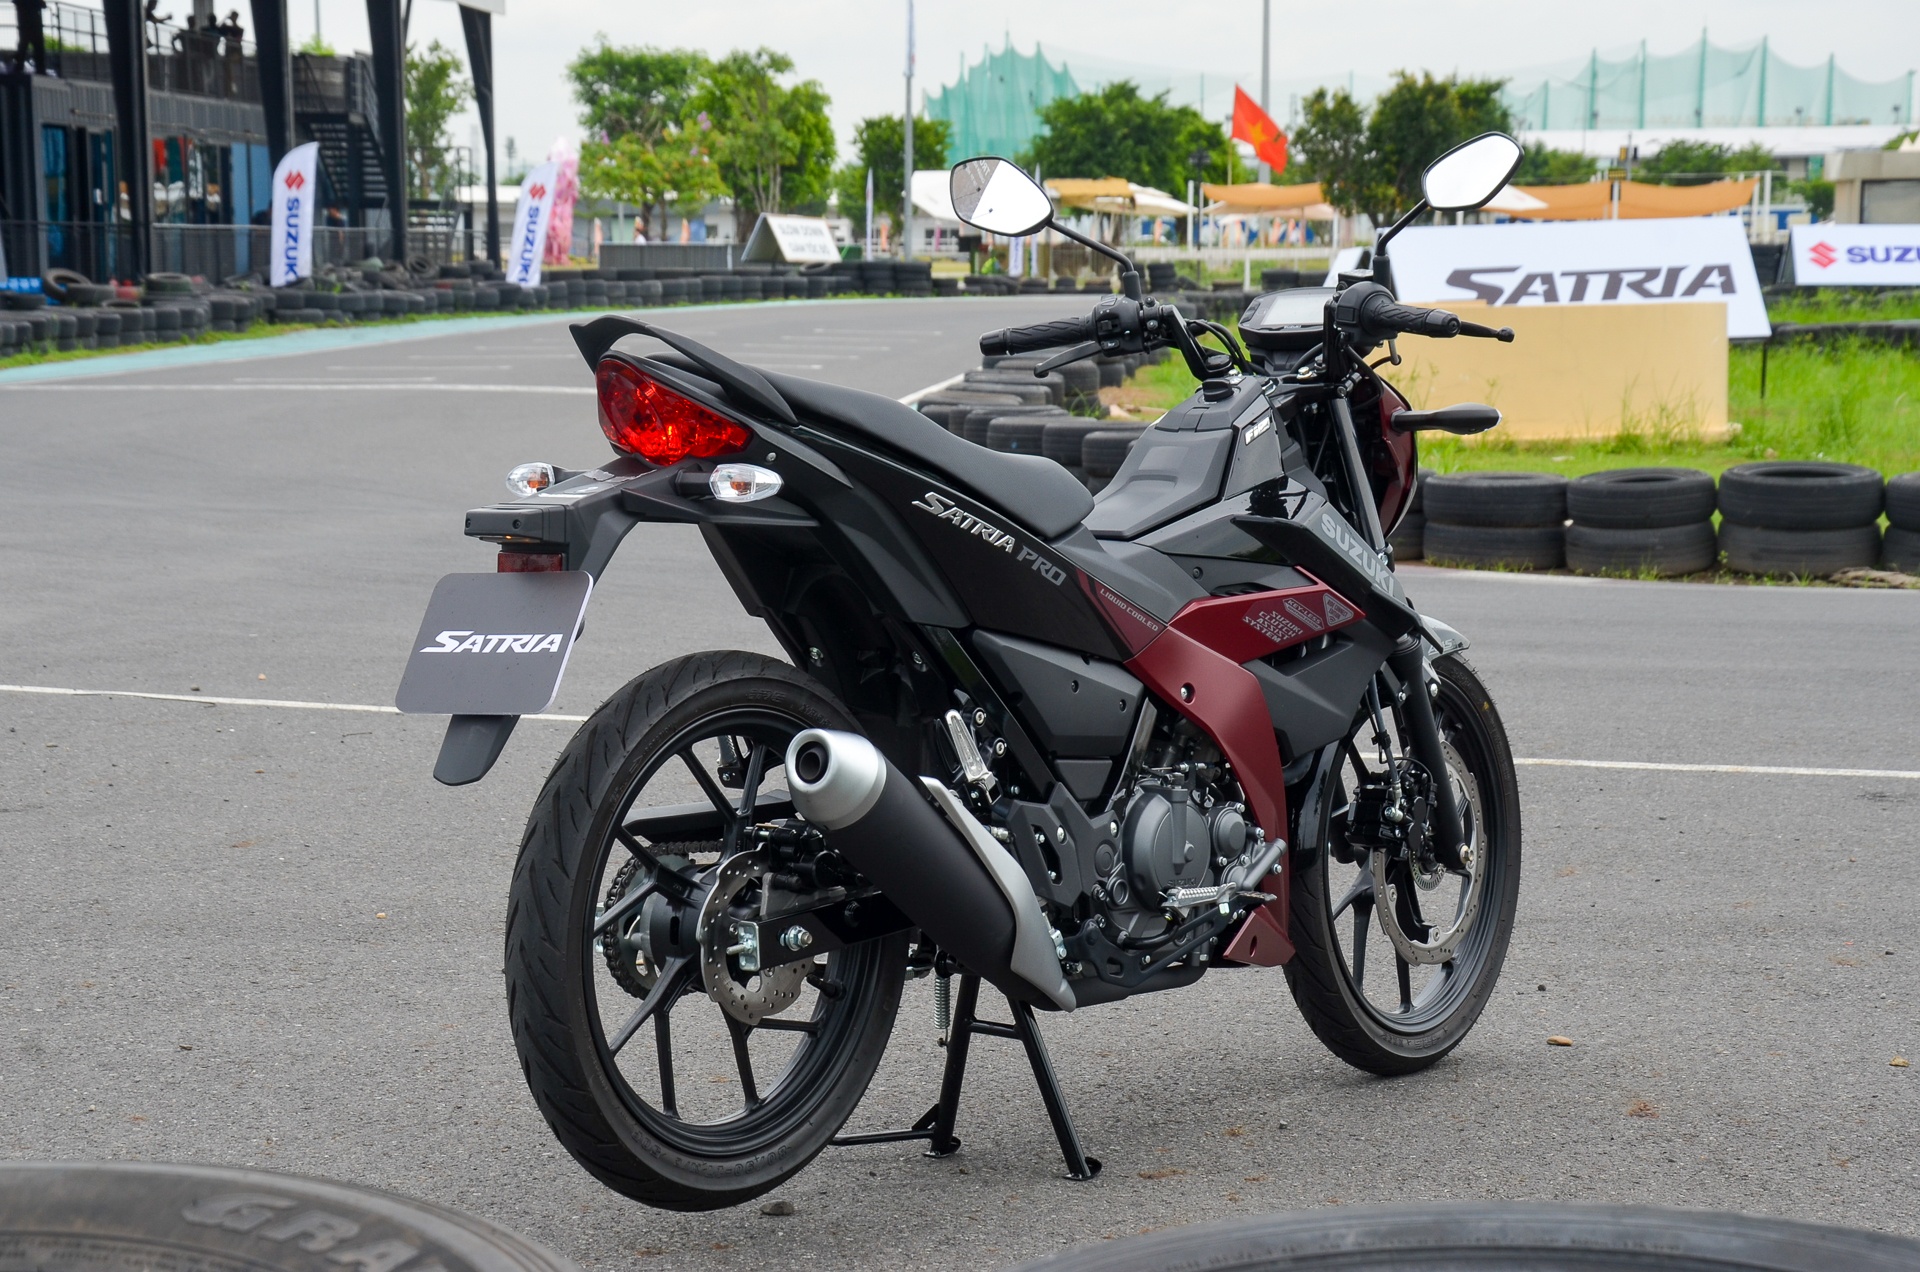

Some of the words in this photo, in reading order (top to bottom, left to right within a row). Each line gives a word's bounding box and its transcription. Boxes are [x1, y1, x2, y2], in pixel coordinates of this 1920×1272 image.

[1847, 246, 1920, 263] SUZ
[1446, 263, 1737, 306] SATRIA
[911, 491, 1016, 554] SATRIA
[1016, 545, 1067, 586] PRO
[1321, 513, 1394, 597] SUZUKI
[1100, 588, 1127, 610] LIQUID
[1126, 607, 1159, 632] COOLED
[1270, 610, 1303, 635] SUZUKI
[1287, 599, 1321, 624] KEY-LESS
[1242, 616, 1281, 643] SYSTEM
[1256, 618, 1289, 640] ASSIST
[1259, 611, 1296, 637] CLUTCH
[419, 630, 564, 653] SATRIA
[1428, 639, 1453, 654] AS
